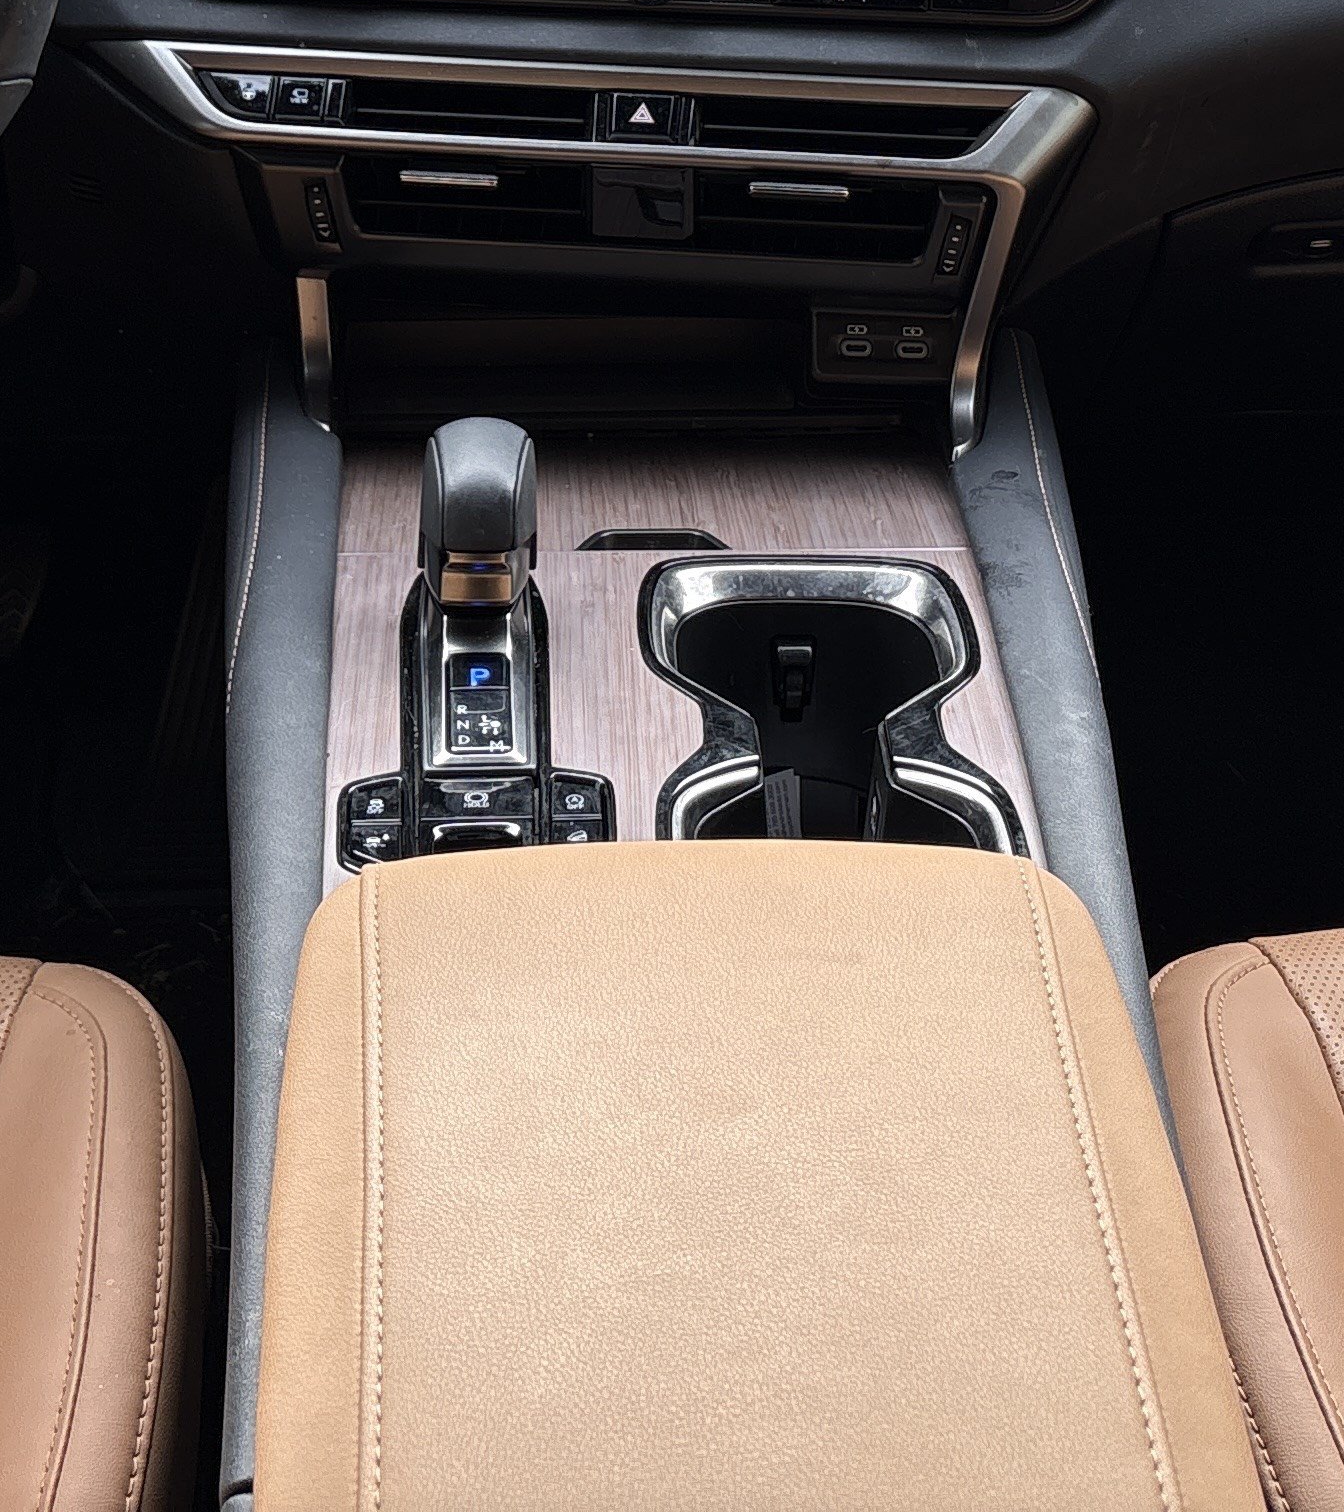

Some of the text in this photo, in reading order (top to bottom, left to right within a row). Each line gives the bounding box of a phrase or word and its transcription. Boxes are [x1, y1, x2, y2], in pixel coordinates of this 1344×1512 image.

[469, 666, 491, 687] P
[456, 704, 468, 715] R
[456, 719, 471, 731] N
[457, 734, 471, 746] D
